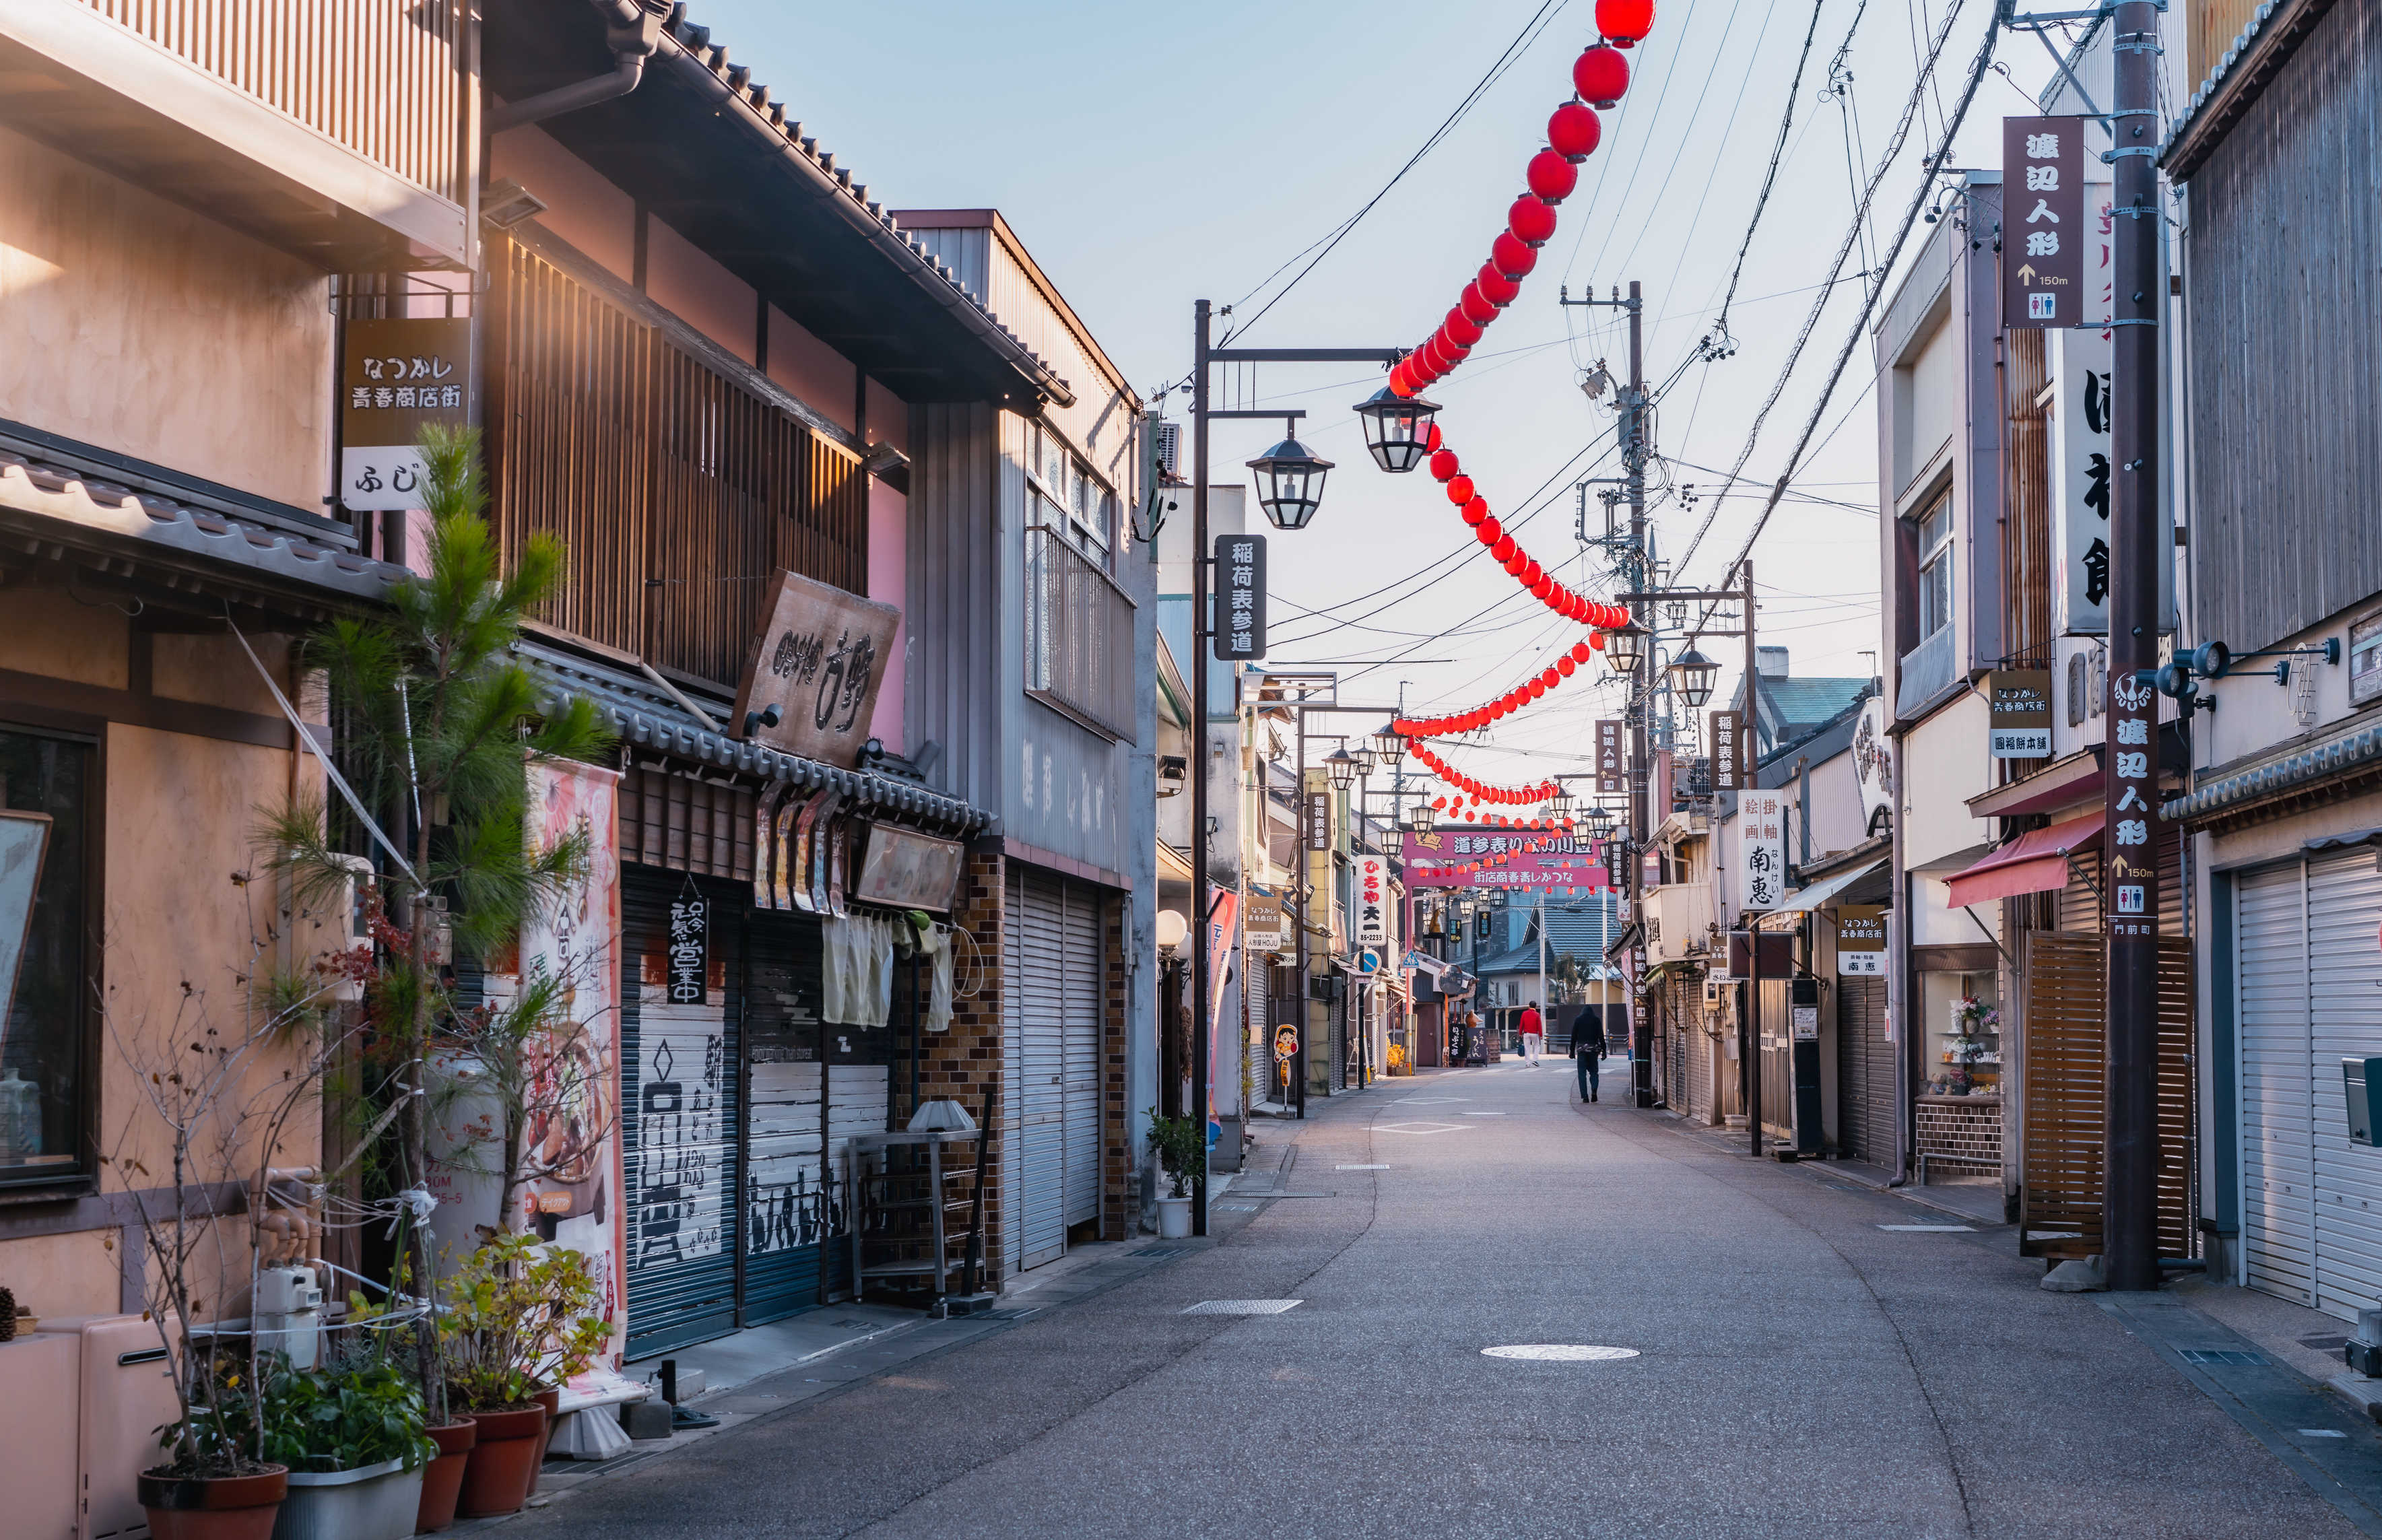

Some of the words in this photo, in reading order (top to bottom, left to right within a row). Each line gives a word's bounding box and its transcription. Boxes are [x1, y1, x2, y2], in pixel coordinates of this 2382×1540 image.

[2026, 133, 2059, 257] 渡辺人形
[2039, 276, 2068, 286] 150m
[364, 356, 453, 380] なつかし
[352, 384, 461, 409] 青春商店街
[1231, 543, 1253, 652] 稲荷表参道
[1993, 700, 2046, 712] 青春商店街
[1998, 688, 2041, 700] なつかし
[1718, 716, 1733, 786] 稲荷表参道
[2116, 718, 2148, 846] 渡辺人形
[1314, 797, 1325, 848] 稲荷表参道
[1746, 799, 1758, 840] 絵画
[1763, 799, 1777, 840] 掛軸
[1612, 844, 1622, 885] 稲荷表参道
[1771, 849, 1779, 894] なんけい
[2128, 868, 2154, 878] 150m
[1841, 929, 1882, 938] 青春商店街
[1845, 918, 1878, 927] なつかし
[2115, 925, 2150, 935] 門前町
[669, 939, 704, 1003] 営業中
